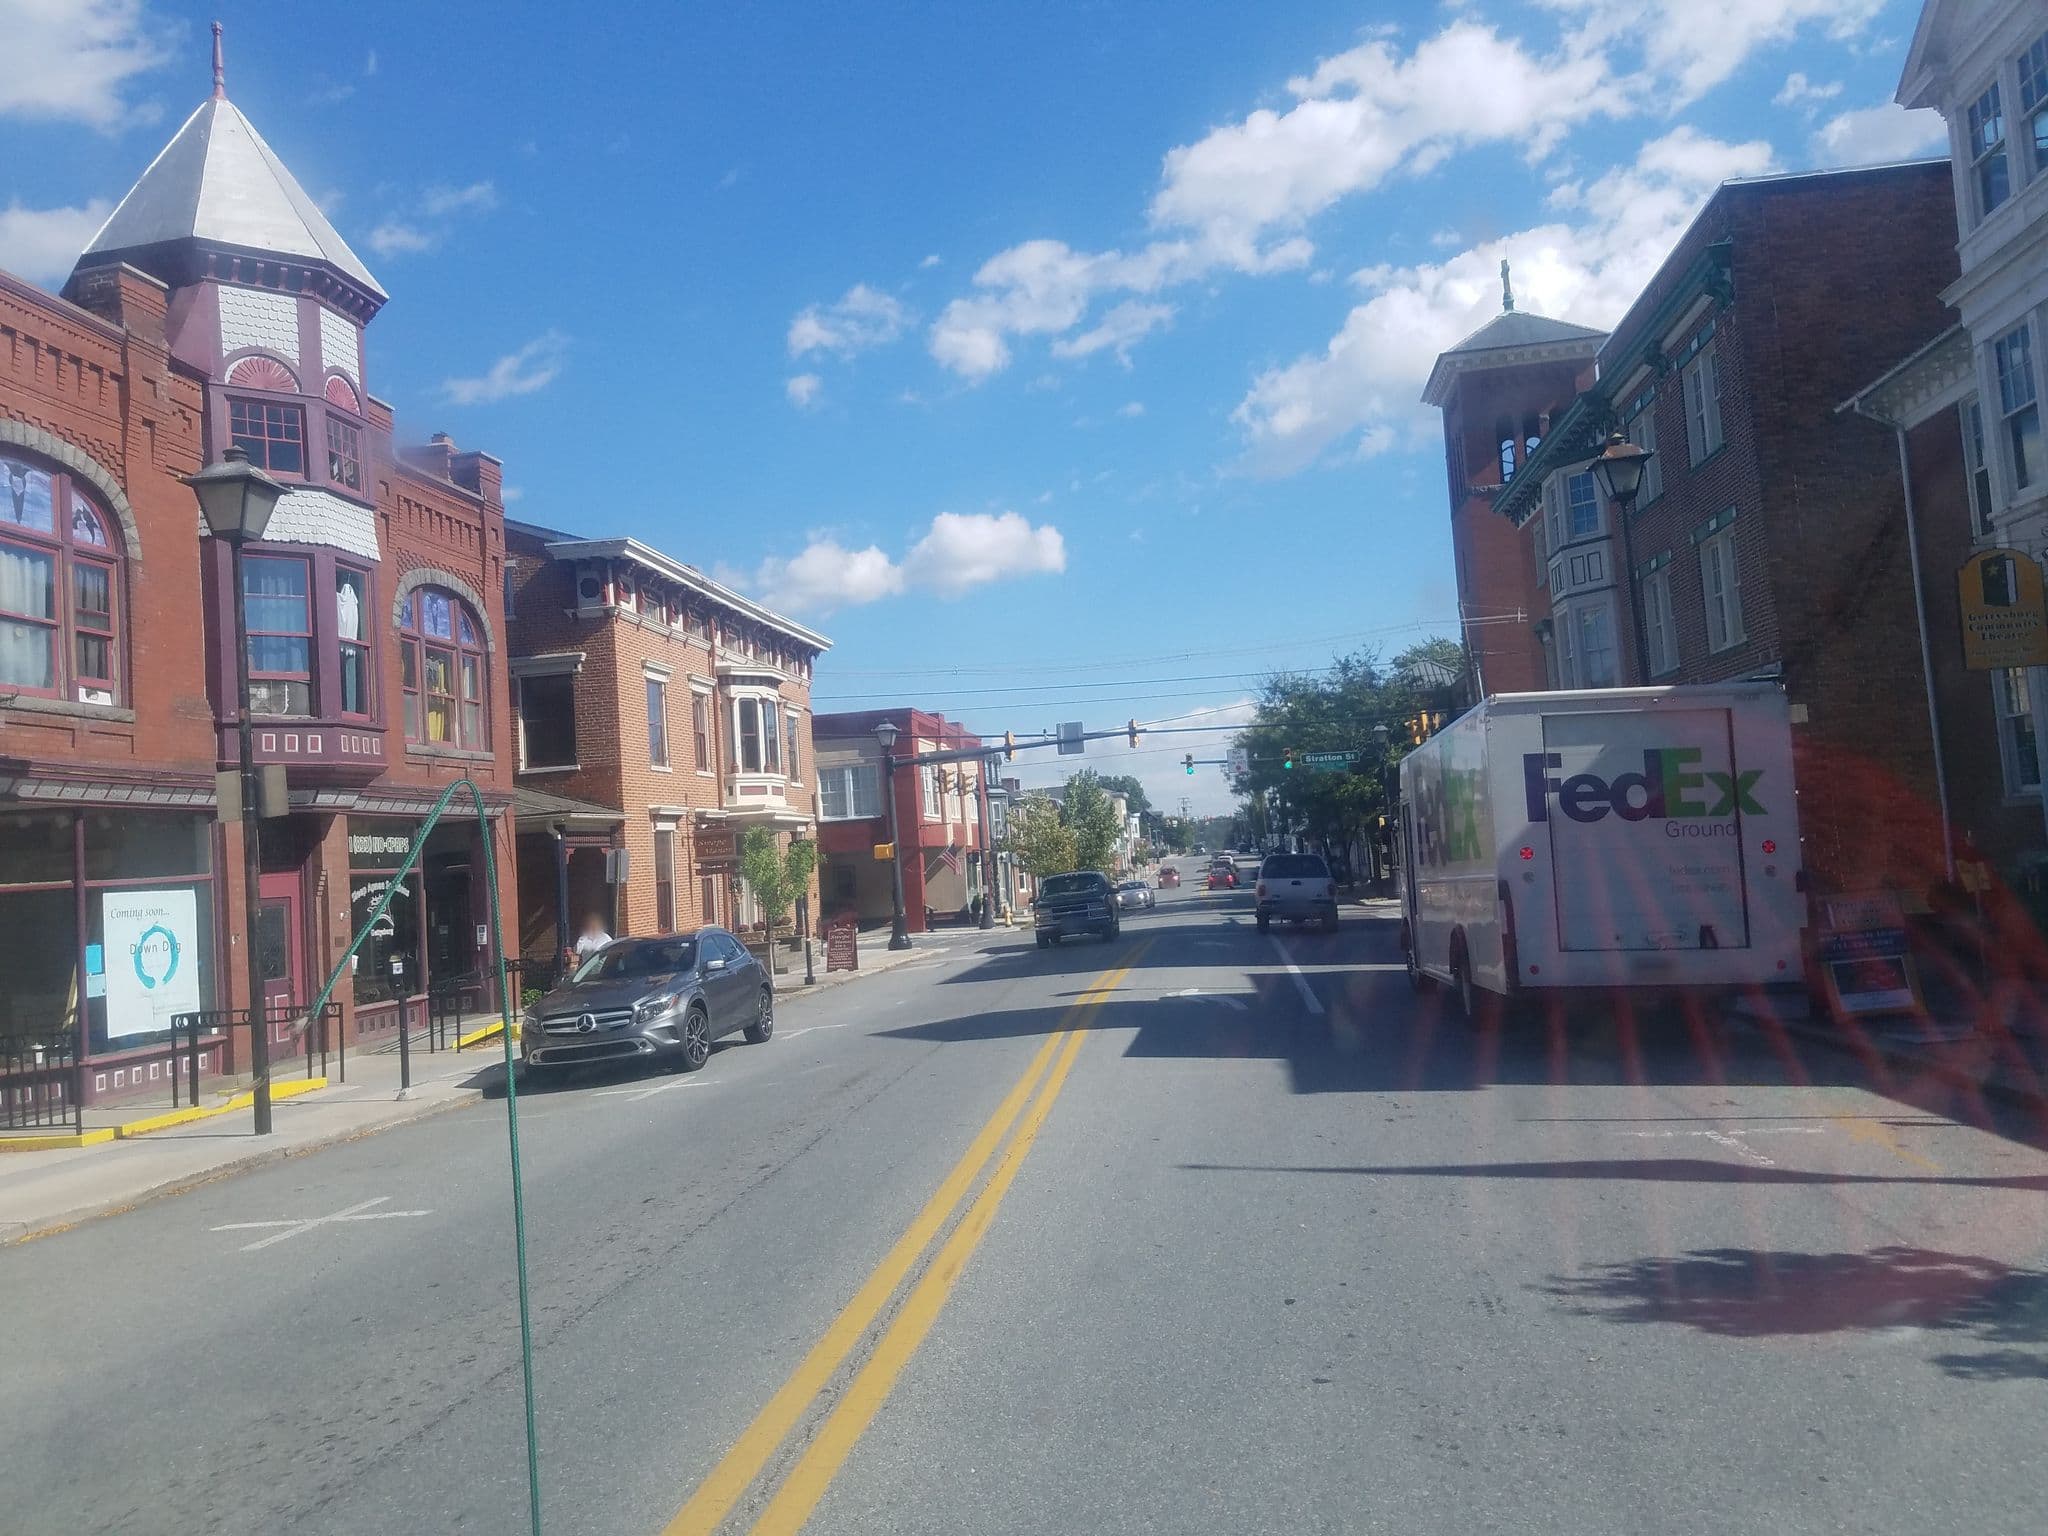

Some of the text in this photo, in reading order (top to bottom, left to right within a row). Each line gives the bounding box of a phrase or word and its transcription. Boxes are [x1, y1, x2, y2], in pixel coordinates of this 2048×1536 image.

[1305, 753, 1355, 763] Stratton St
[1523, 747, 1769, 823] FedEx
[1665, 820, 1738, 838] Ground
[110, 908, 143, 921] Coming
[129, 940, 181, 955] Down Dog
